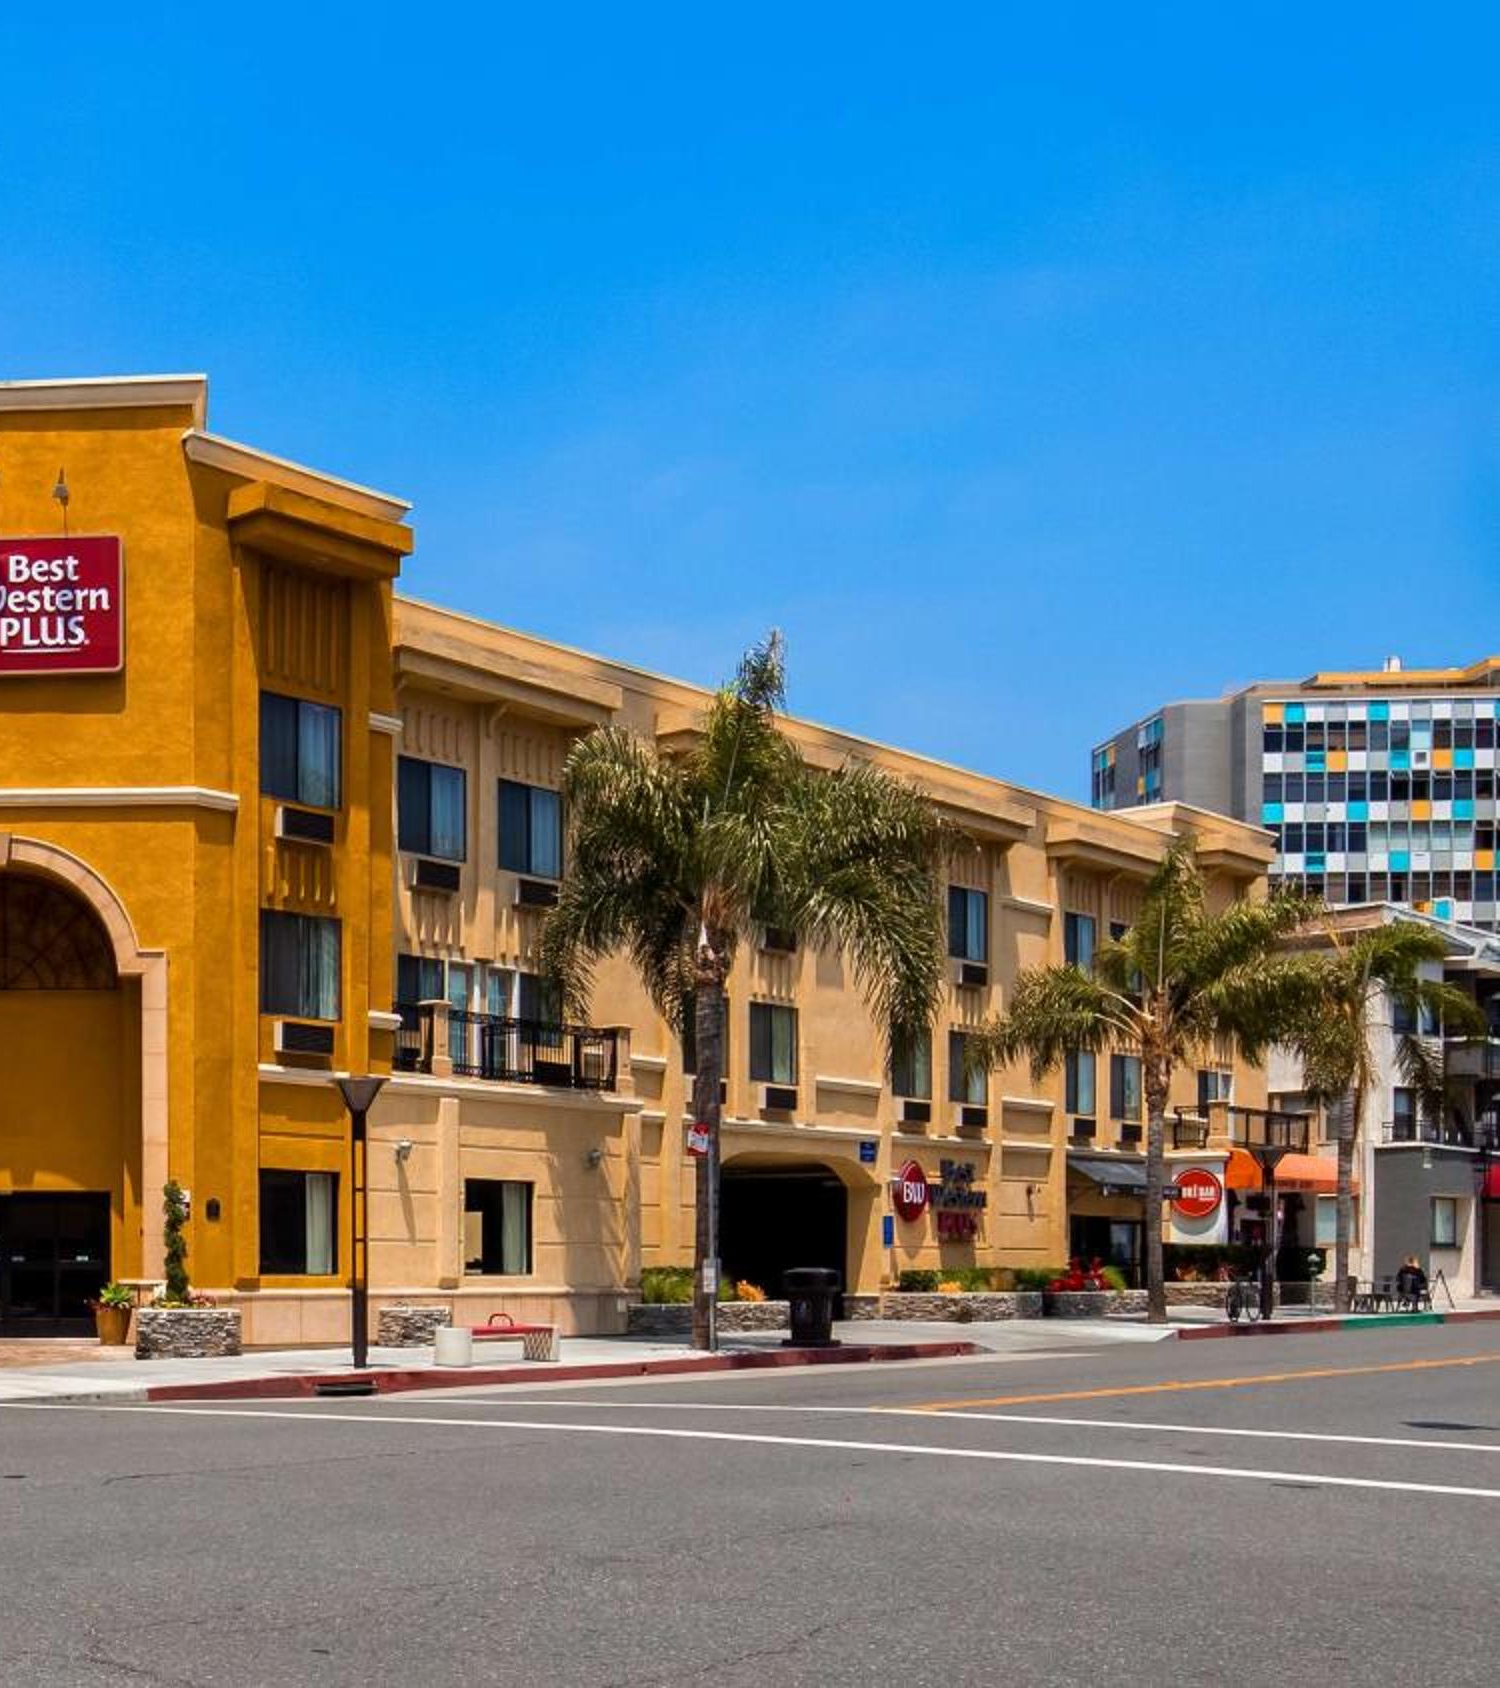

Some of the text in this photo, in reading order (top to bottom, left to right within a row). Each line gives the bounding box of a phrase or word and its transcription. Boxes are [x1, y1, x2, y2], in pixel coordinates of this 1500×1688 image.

[8, 554, 79, 583] Best
[0, 615, 86, 646] PLUS
[903, 1181, 925, 1203] BW
